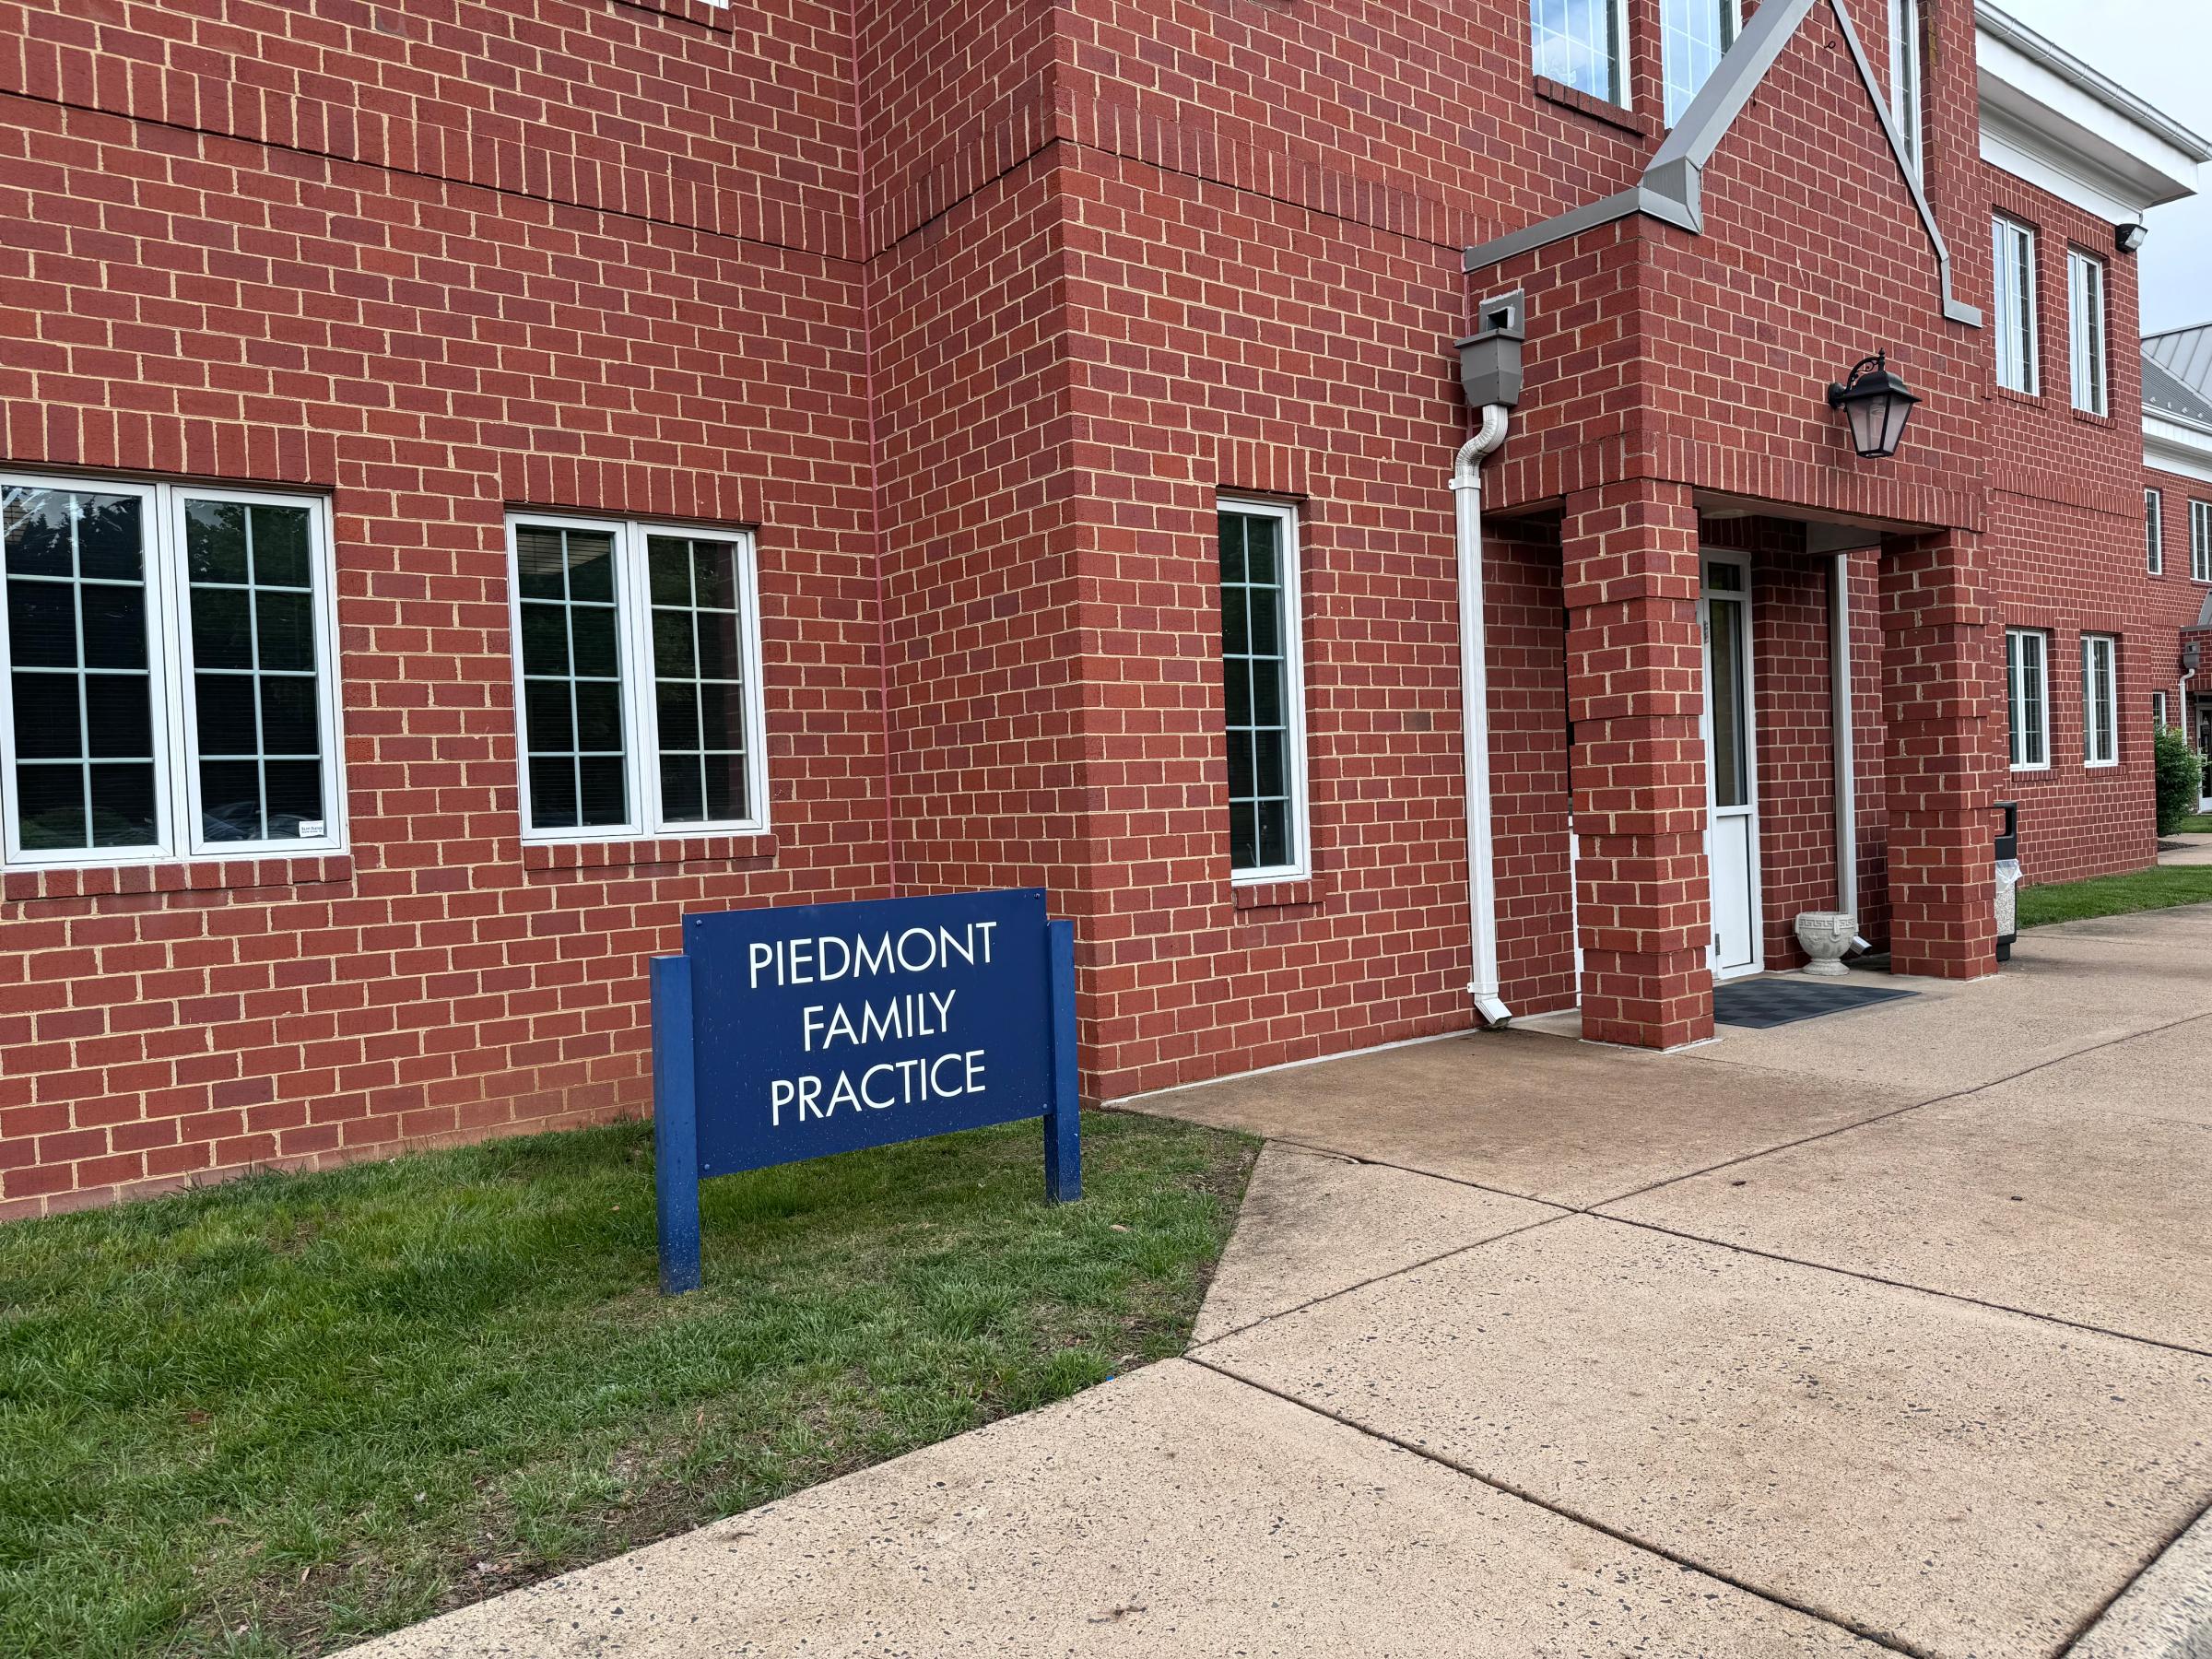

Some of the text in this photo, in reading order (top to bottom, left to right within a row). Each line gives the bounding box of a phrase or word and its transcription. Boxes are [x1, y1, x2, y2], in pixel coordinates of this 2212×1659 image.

[749, 921, 997, 989] PIEDMONT
[803, 989, 957, 1052] FAMILY
[771, 1049, 986, 1126] PRACTICE
